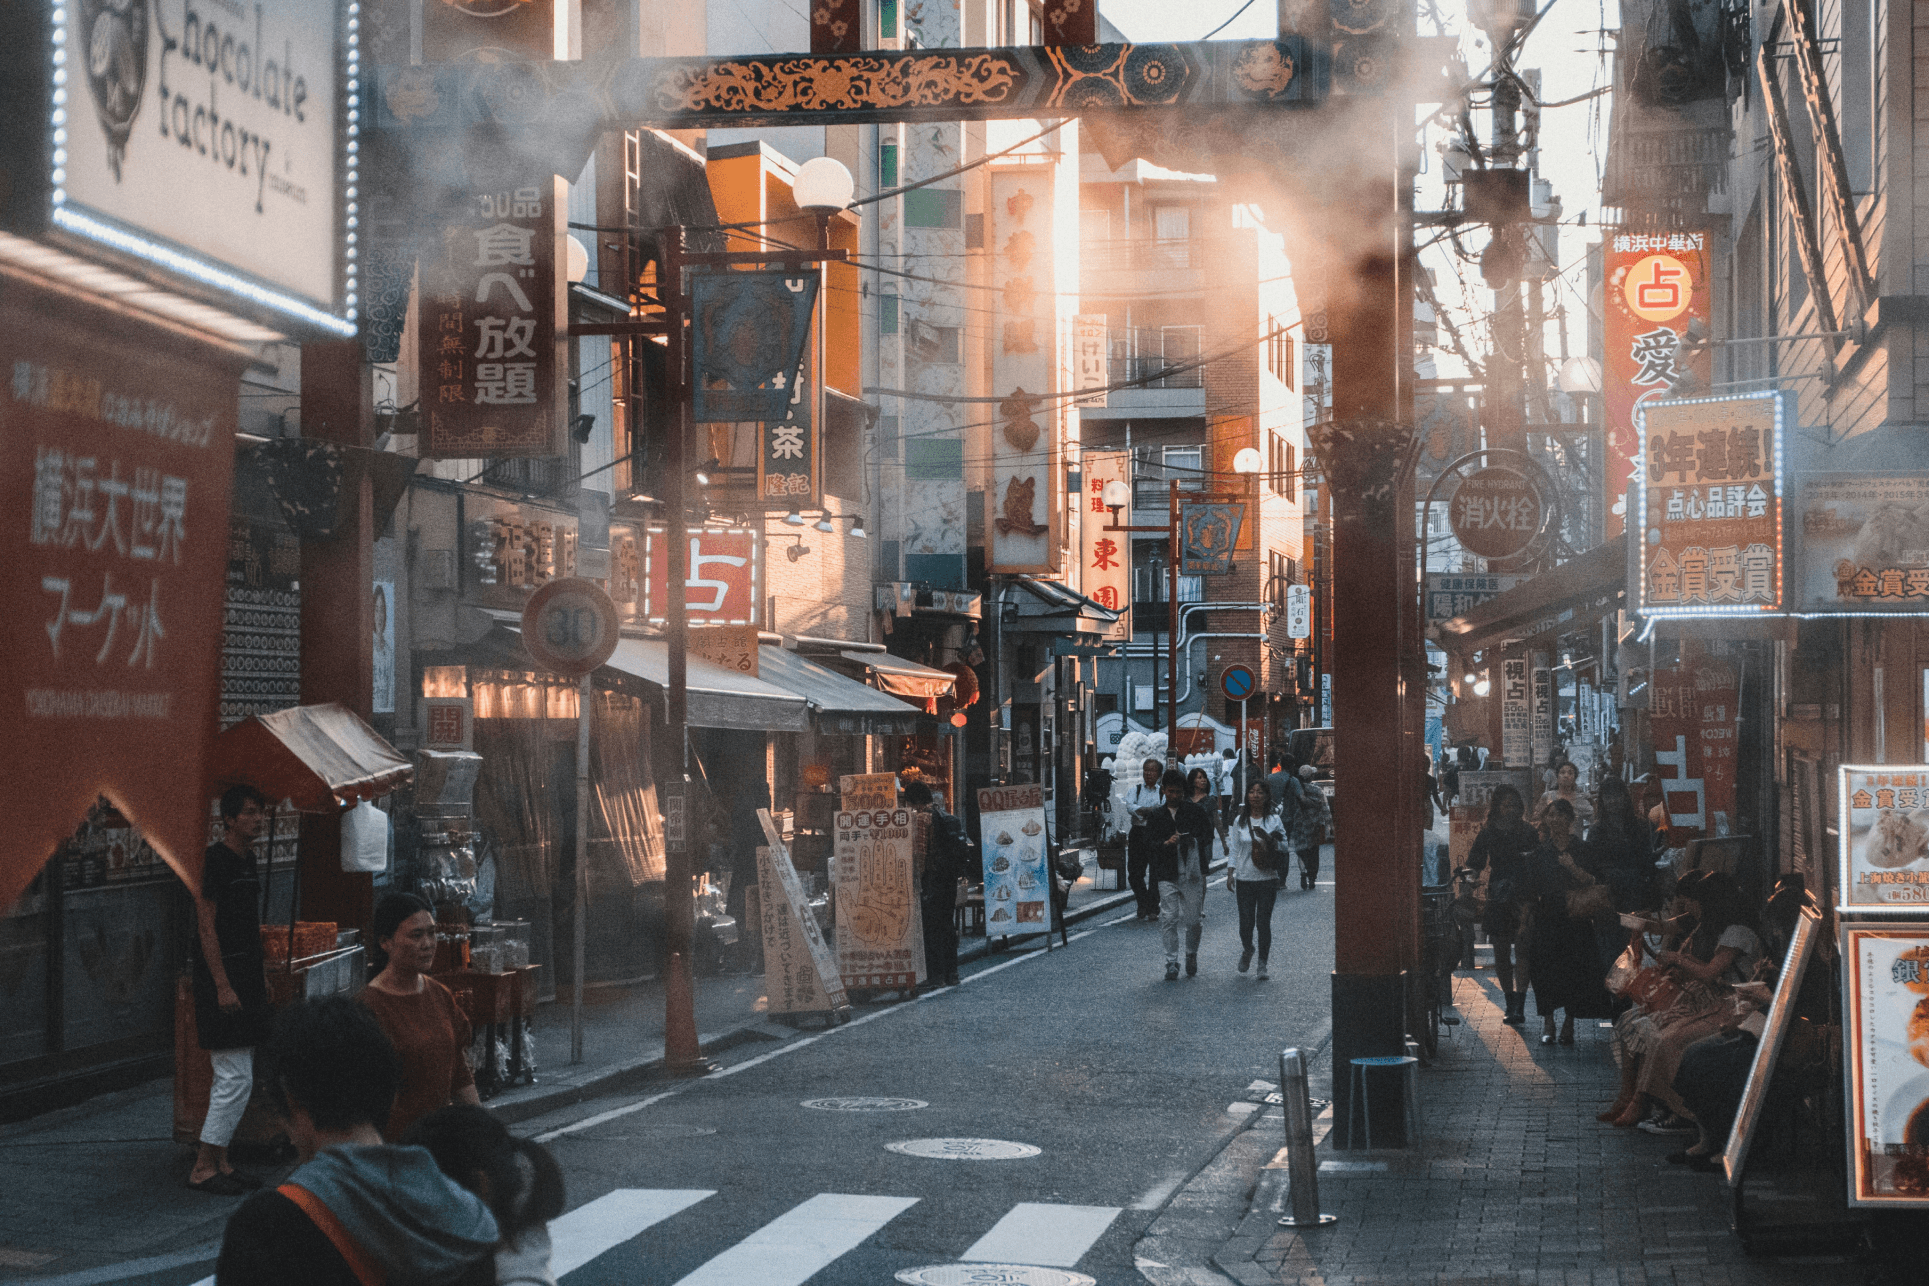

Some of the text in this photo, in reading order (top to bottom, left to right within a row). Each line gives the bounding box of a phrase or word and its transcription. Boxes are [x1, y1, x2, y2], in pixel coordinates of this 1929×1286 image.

[1613, 234, 1704, 253] 横浜中華街
[1638, 259, 1684, 311] 占
[473, 222, 537, 404] 食べ放題
[765, 473, 811, 496] 隆記
[1466, 480, 1526, 490] FIRE HYDRANT
[1666, 484, 1769, 521] 点心品評会
[1458, 495, 1535, 531] 消火栓
[1648, 543, 1779, 604] 金賞受賞
[546, 608, 598, 646] 30
[838, 810, 909, 829] 開運手相
[1891, 957, 1929, 984] 銀
